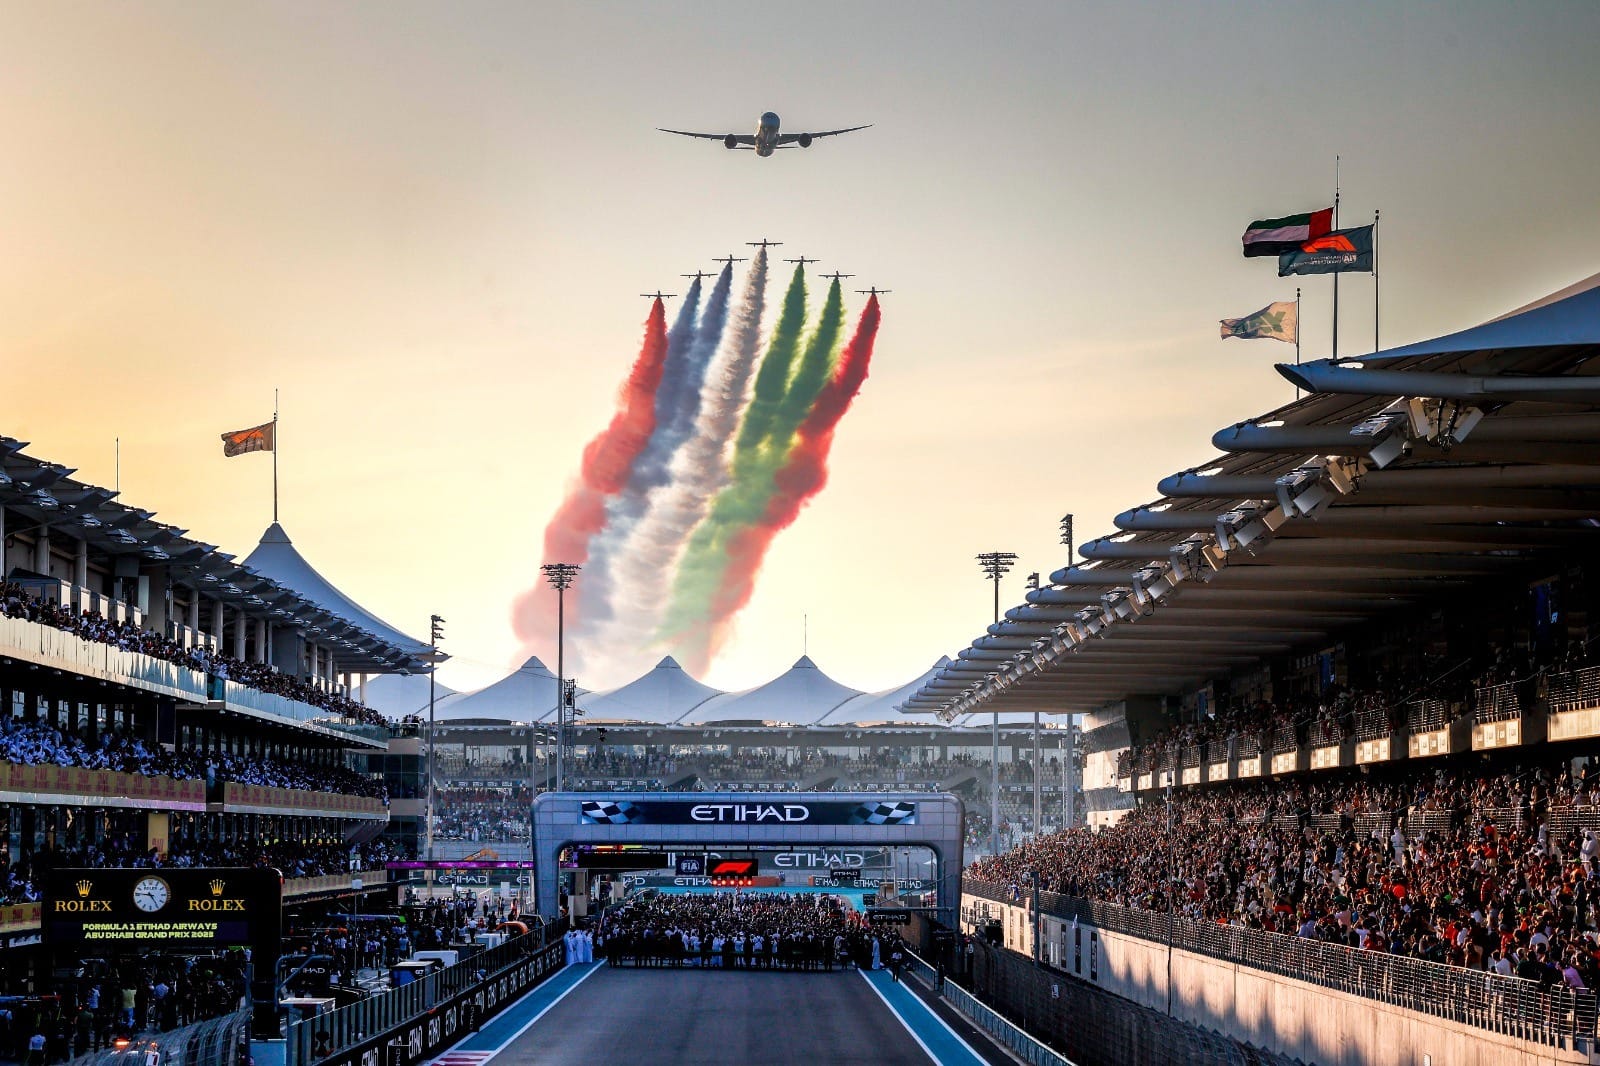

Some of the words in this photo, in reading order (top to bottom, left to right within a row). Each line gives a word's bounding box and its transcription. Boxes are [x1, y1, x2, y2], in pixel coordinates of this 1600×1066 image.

[690, 804, 810, 822] ETIHAD
[774, 853, 864, 867] ETIHAD
[682, 862, 698, 871] FIA
[438, 875, 488, 884] EIHAD
[673, 877, 713, 887] ETIHA
[853, 879, 880, 888] ETIHAD
[54, 900, 112, 912] ROLEX
[188, 899, 246, 911] ROLEX
[82, 923, 129, 931] FORMULA
[84, 931, 105, 939] ABU
